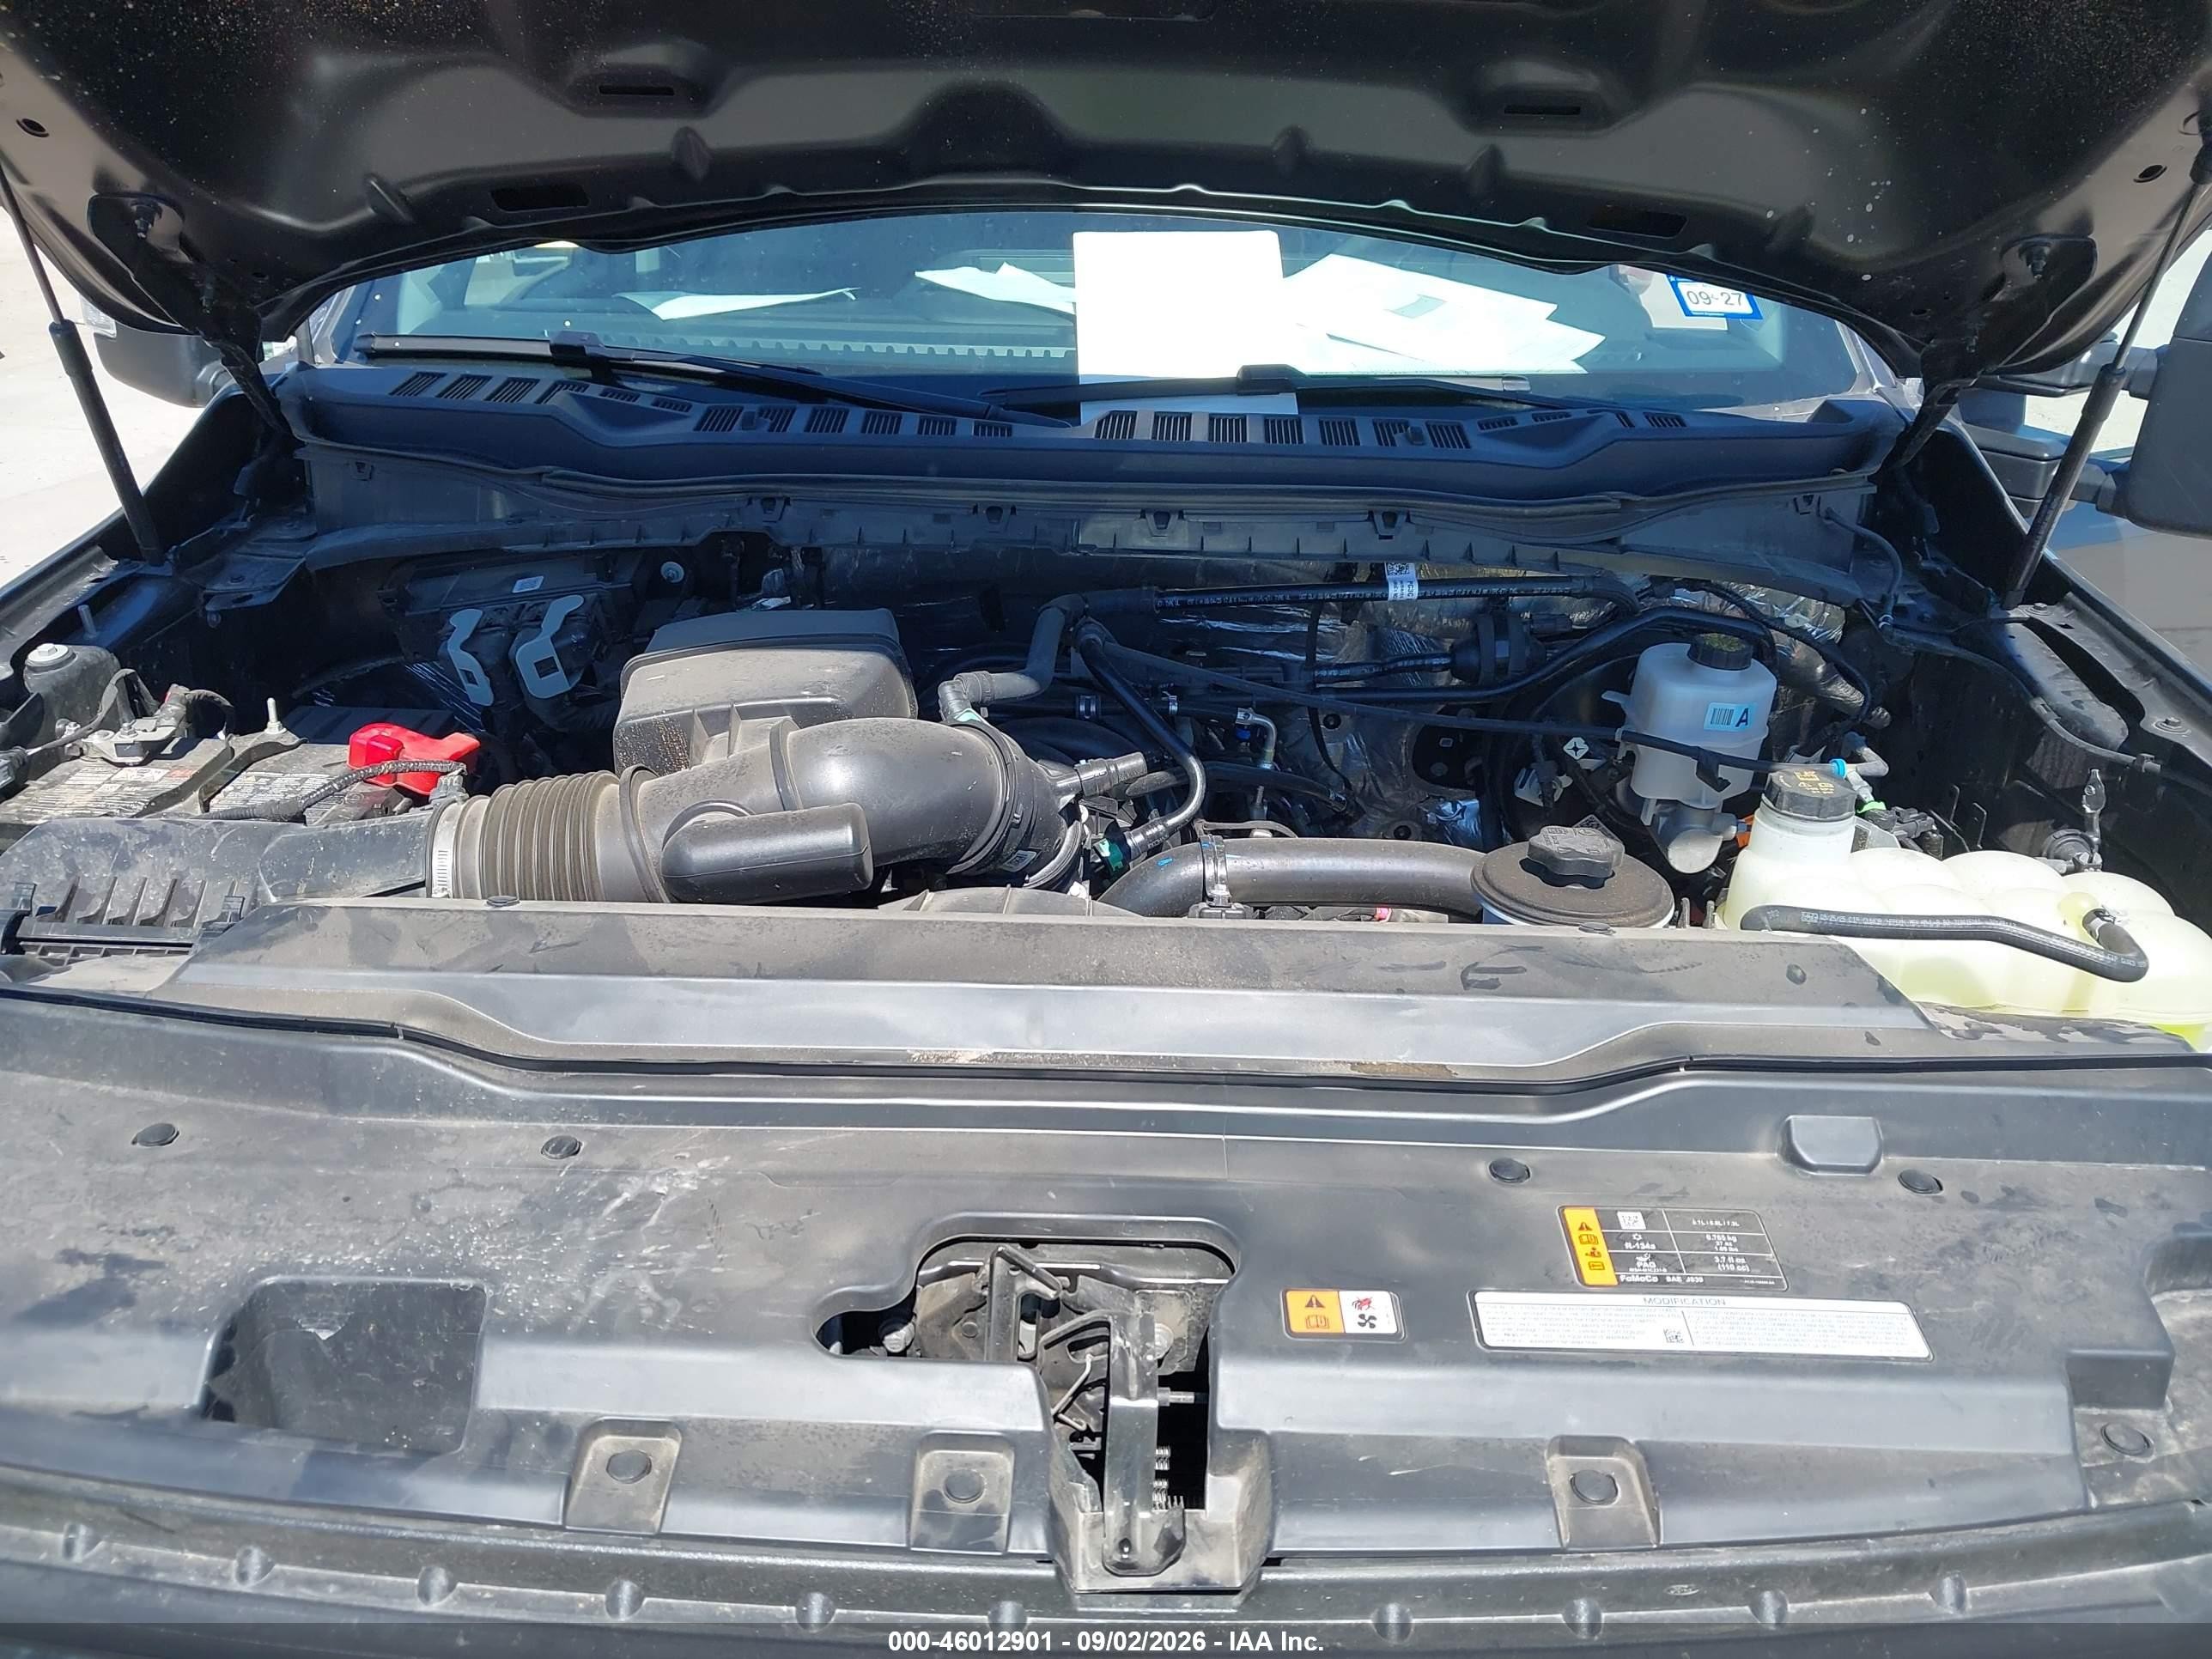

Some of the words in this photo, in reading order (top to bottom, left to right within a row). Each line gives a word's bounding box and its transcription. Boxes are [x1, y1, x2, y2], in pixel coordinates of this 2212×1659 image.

[1735, 708, 1749, 727] A
[1620, 1274, 1659, 1283] FoMoCo
[1643, 1297, 1727, 1306] MODIFICATION
